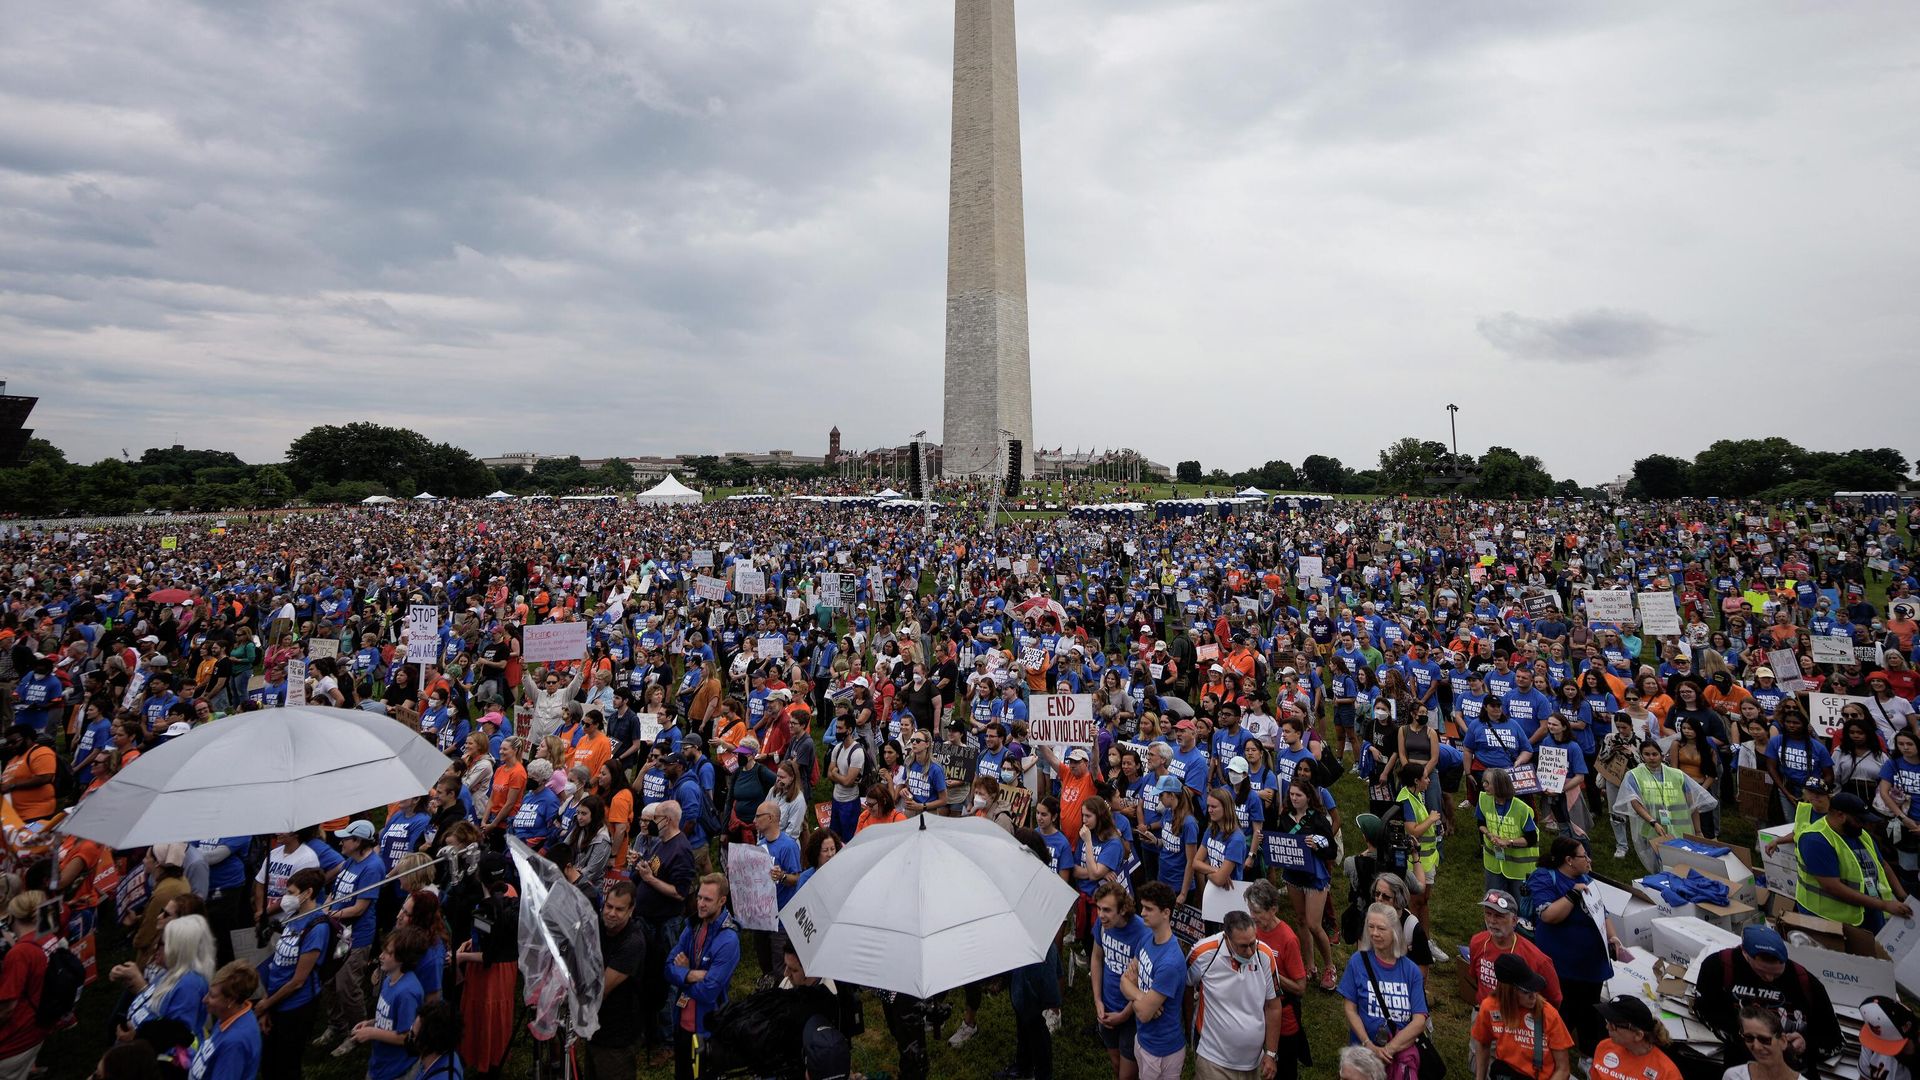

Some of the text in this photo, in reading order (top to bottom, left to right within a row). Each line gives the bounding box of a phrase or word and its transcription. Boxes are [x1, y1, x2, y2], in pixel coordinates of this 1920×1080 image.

[821, 582, 840, 593] CONTR
[411, 608, 437, 623] STOP
[1047, 696, 1075, 717] END
[1509, 699, 1531, 707] MARCH
[1822, 697, 1848, 707] GET
[1828, 707, 1842, 716] TH
[1818, 715, 1844, 727] LEA
[1031, 720, 1093, 743] GUN VIOLENCE
[1541, 747, 1551, 756] One
[1171, 758, 1186, 770] ARCH
[945, 766, 967, 781] MEN
[1515, 771, 1535, 781] NEXT
[1513, 780, 1536, 789] 54-954
[1269, 836, 1298, 847] MARCH
[1269, 845, 1304, 857] FOR OUR
[1271, 854, 1293, 865] LIVES
[1172, 909, 1205, 932] EXT NEX
[802, 918, 817, 944] NBC
[1176, 922, 1206, 940] 954-95
[1480, 974, 1498, 985] ACTI
[1623, 966, 1649, 982] GILDAN
[1822, 969, 1859, 983] GILDAN
[1732, 984, 1781, 1000] KILL THE
[1594, 1063, 1609, 1076] END
